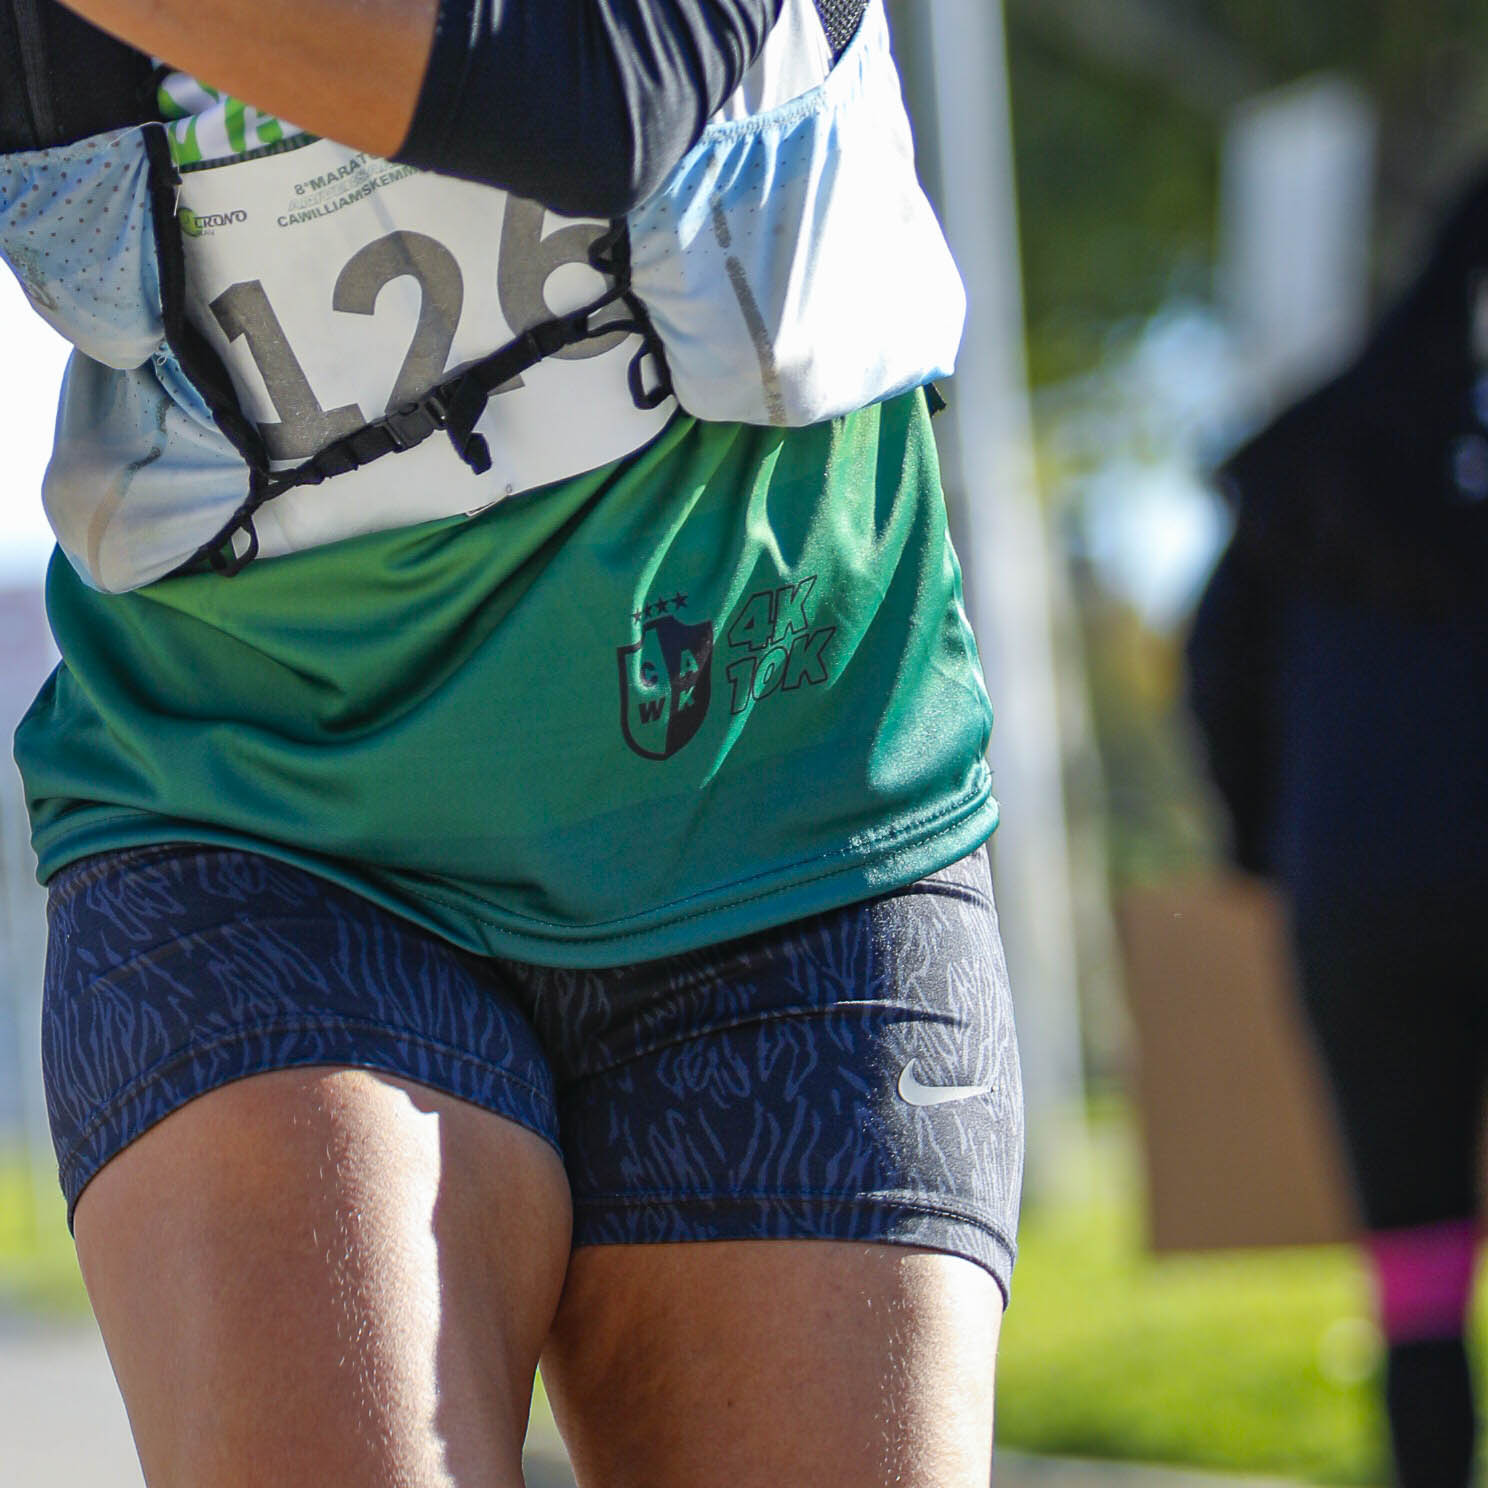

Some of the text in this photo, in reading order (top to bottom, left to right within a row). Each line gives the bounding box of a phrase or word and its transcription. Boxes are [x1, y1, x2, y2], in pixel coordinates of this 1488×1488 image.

[209, 192, 634, 461] 126
[727, 574, 818, 651] 4K
[725, 626, 837, 716] 10K
